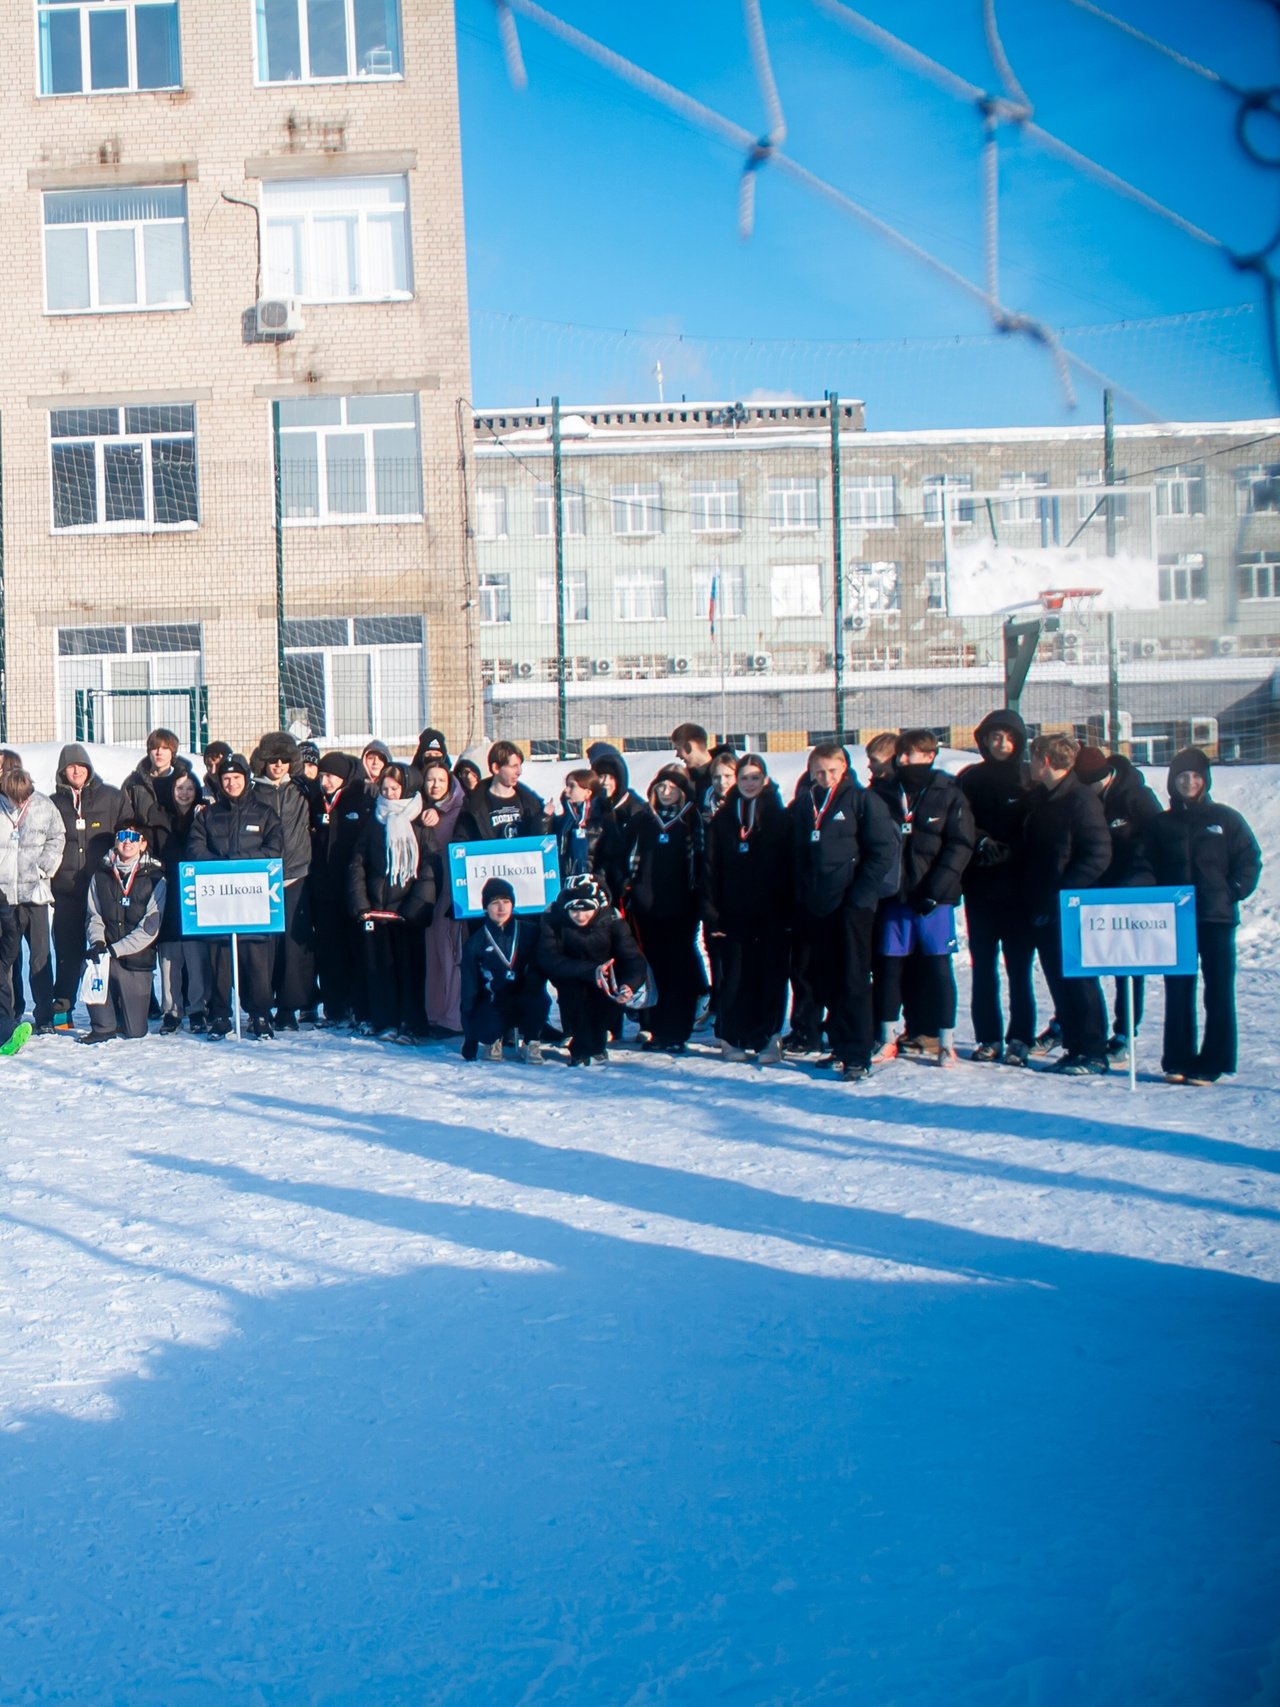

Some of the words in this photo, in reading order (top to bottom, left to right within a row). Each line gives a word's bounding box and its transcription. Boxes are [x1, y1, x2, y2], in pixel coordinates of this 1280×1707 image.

[473, 867, 487, 879] 13
[490, 864, 538, 879] Школа
[200, 885, 216, 898] 33
[219, 883, 263, 898] Школа
[1088, 917, 1107, 932] 12
[1110, 915, 1168, 932] Школа
